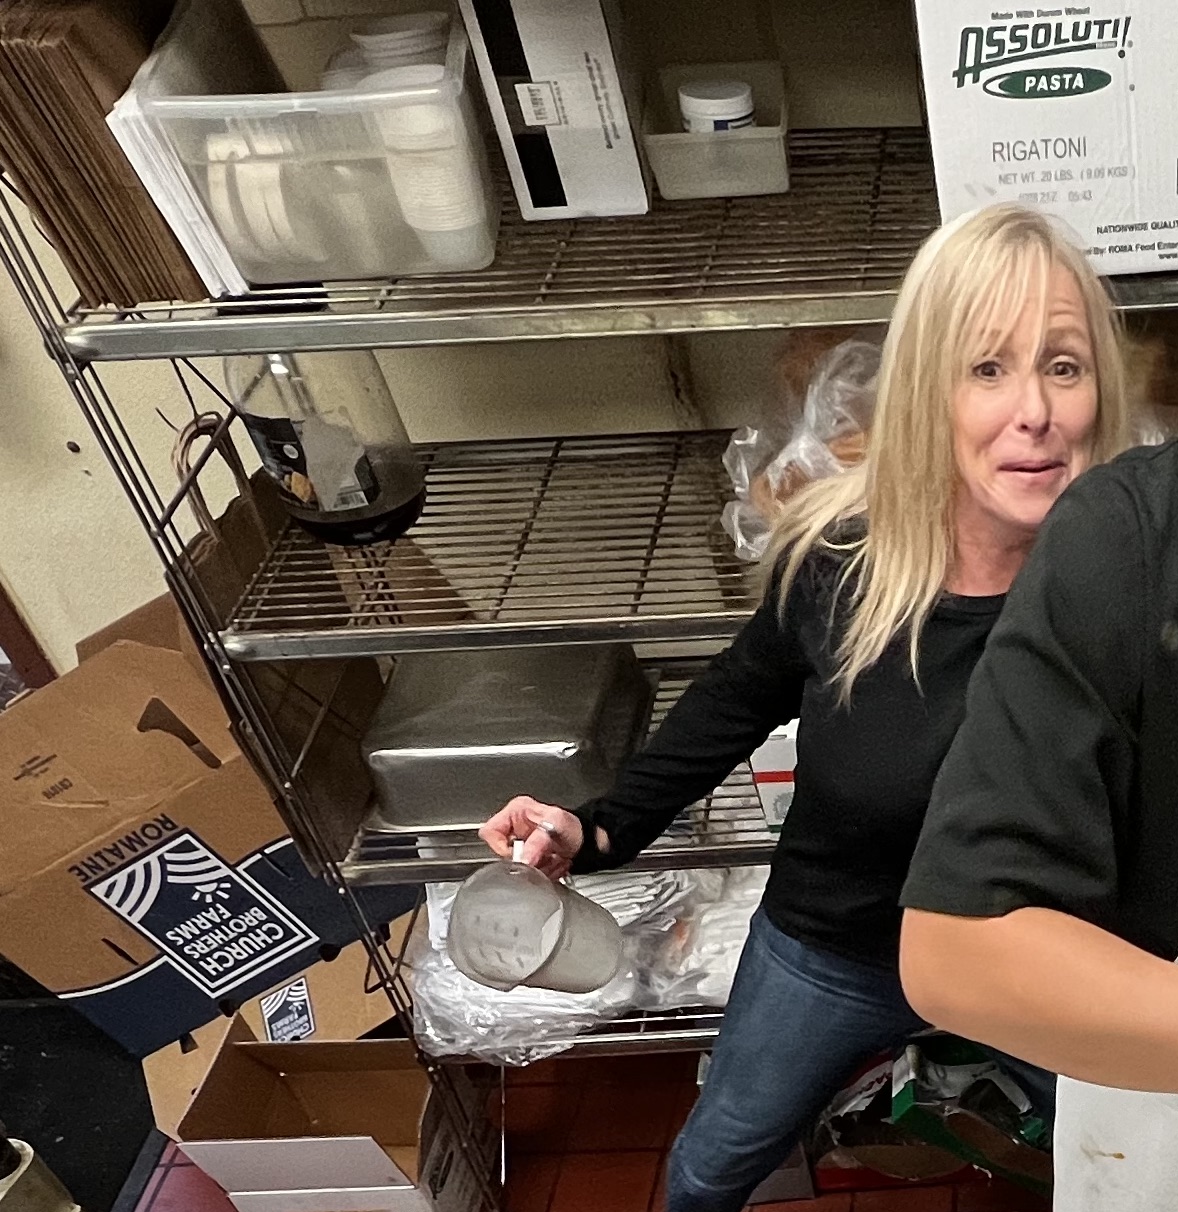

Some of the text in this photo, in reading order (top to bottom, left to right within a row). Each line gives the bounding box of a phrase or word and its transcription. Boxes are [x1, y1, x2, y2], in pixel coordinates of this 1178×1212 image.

[1025, 73, 1085, 93] PASTA
[992, 136, 1087, 163] RIGATONI
[1096, 222, 1148, 235] NATIONWIDE
[1108, 245, 1133, 254] ROMA
[1136, 242, 1156, 252] Food
[68, 812, 181, 884] ROMAINE
[165, 902, 232, 946] FARMS
[183, 905, 268, 959] BROTHERS
[198, 922, 284, 977] CHURCH
